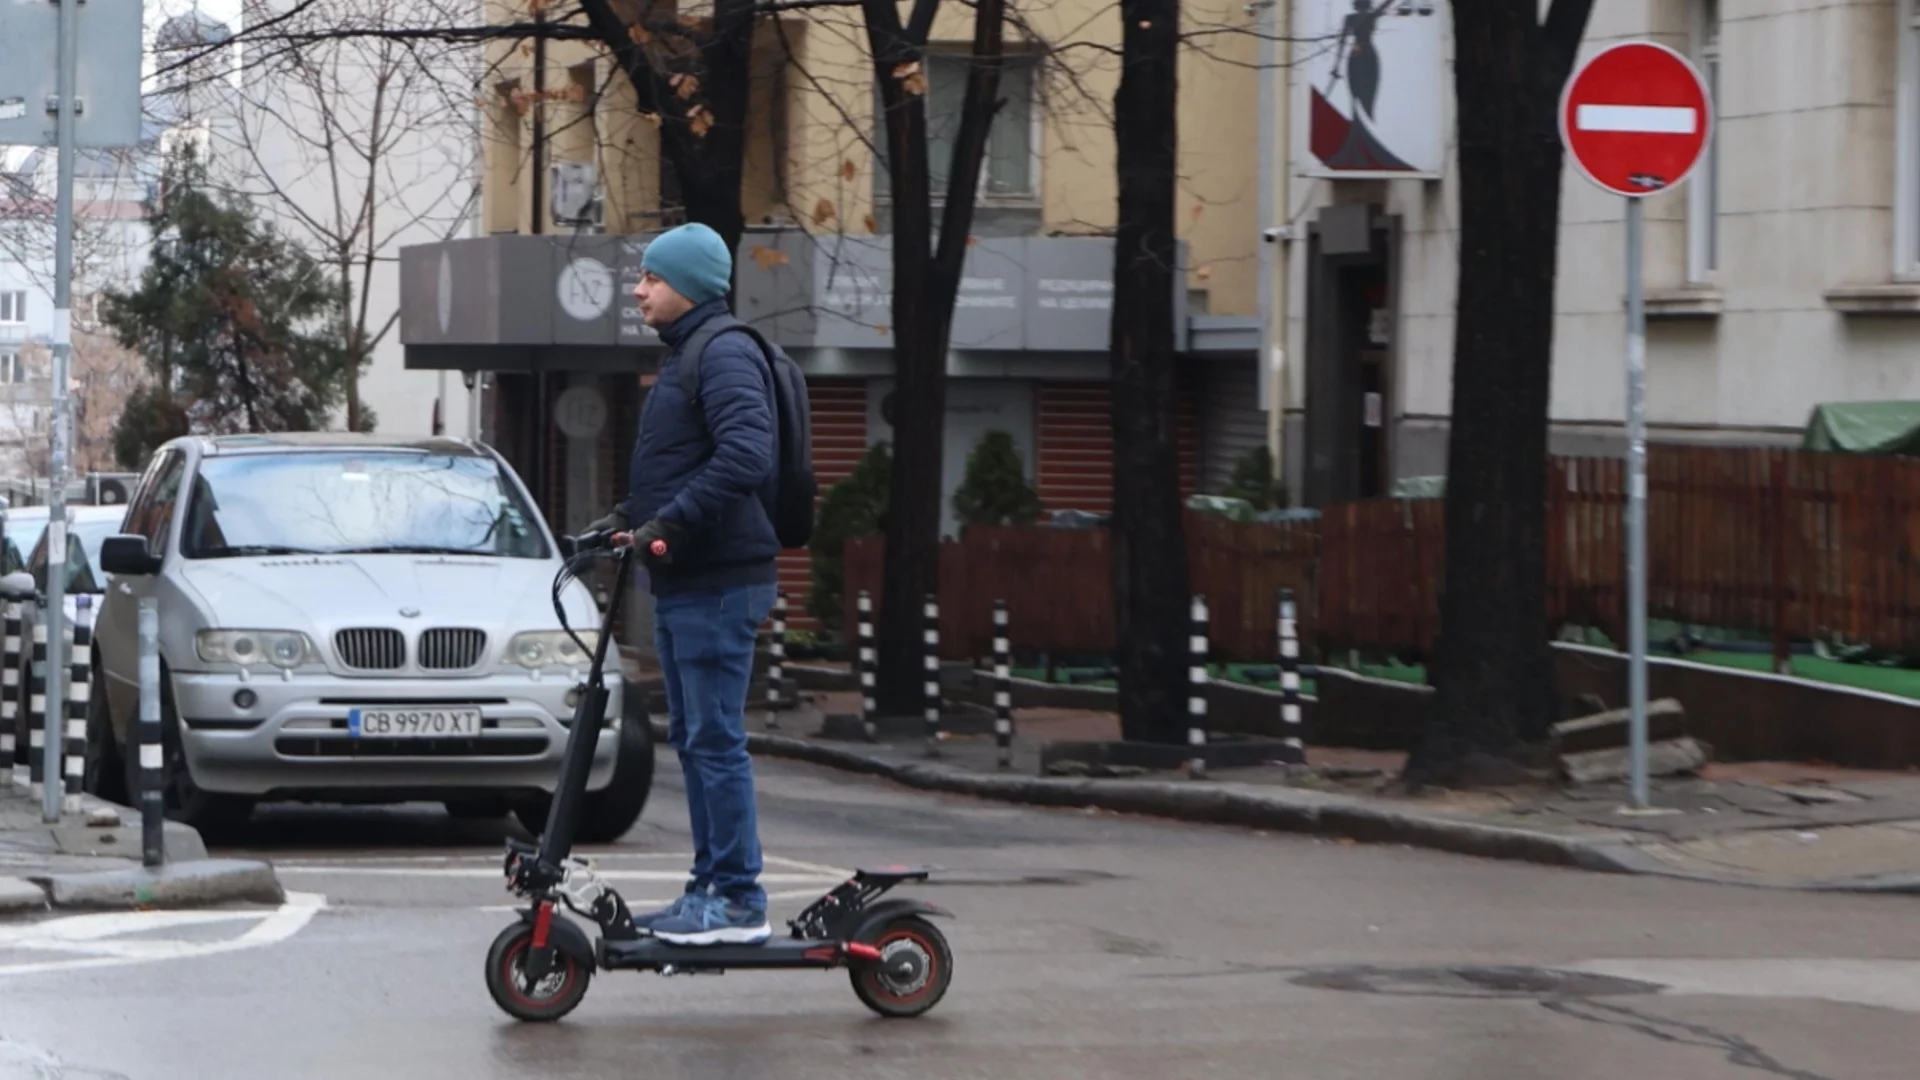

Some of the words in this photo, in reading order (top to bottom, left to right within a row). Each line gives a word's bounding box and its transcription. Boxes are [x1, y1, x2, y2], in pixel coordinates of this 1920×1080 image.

[364, 712, 391, 733] CB
[395, 712, 446, 733] 9970
[450, 712, 476, 732] XT
